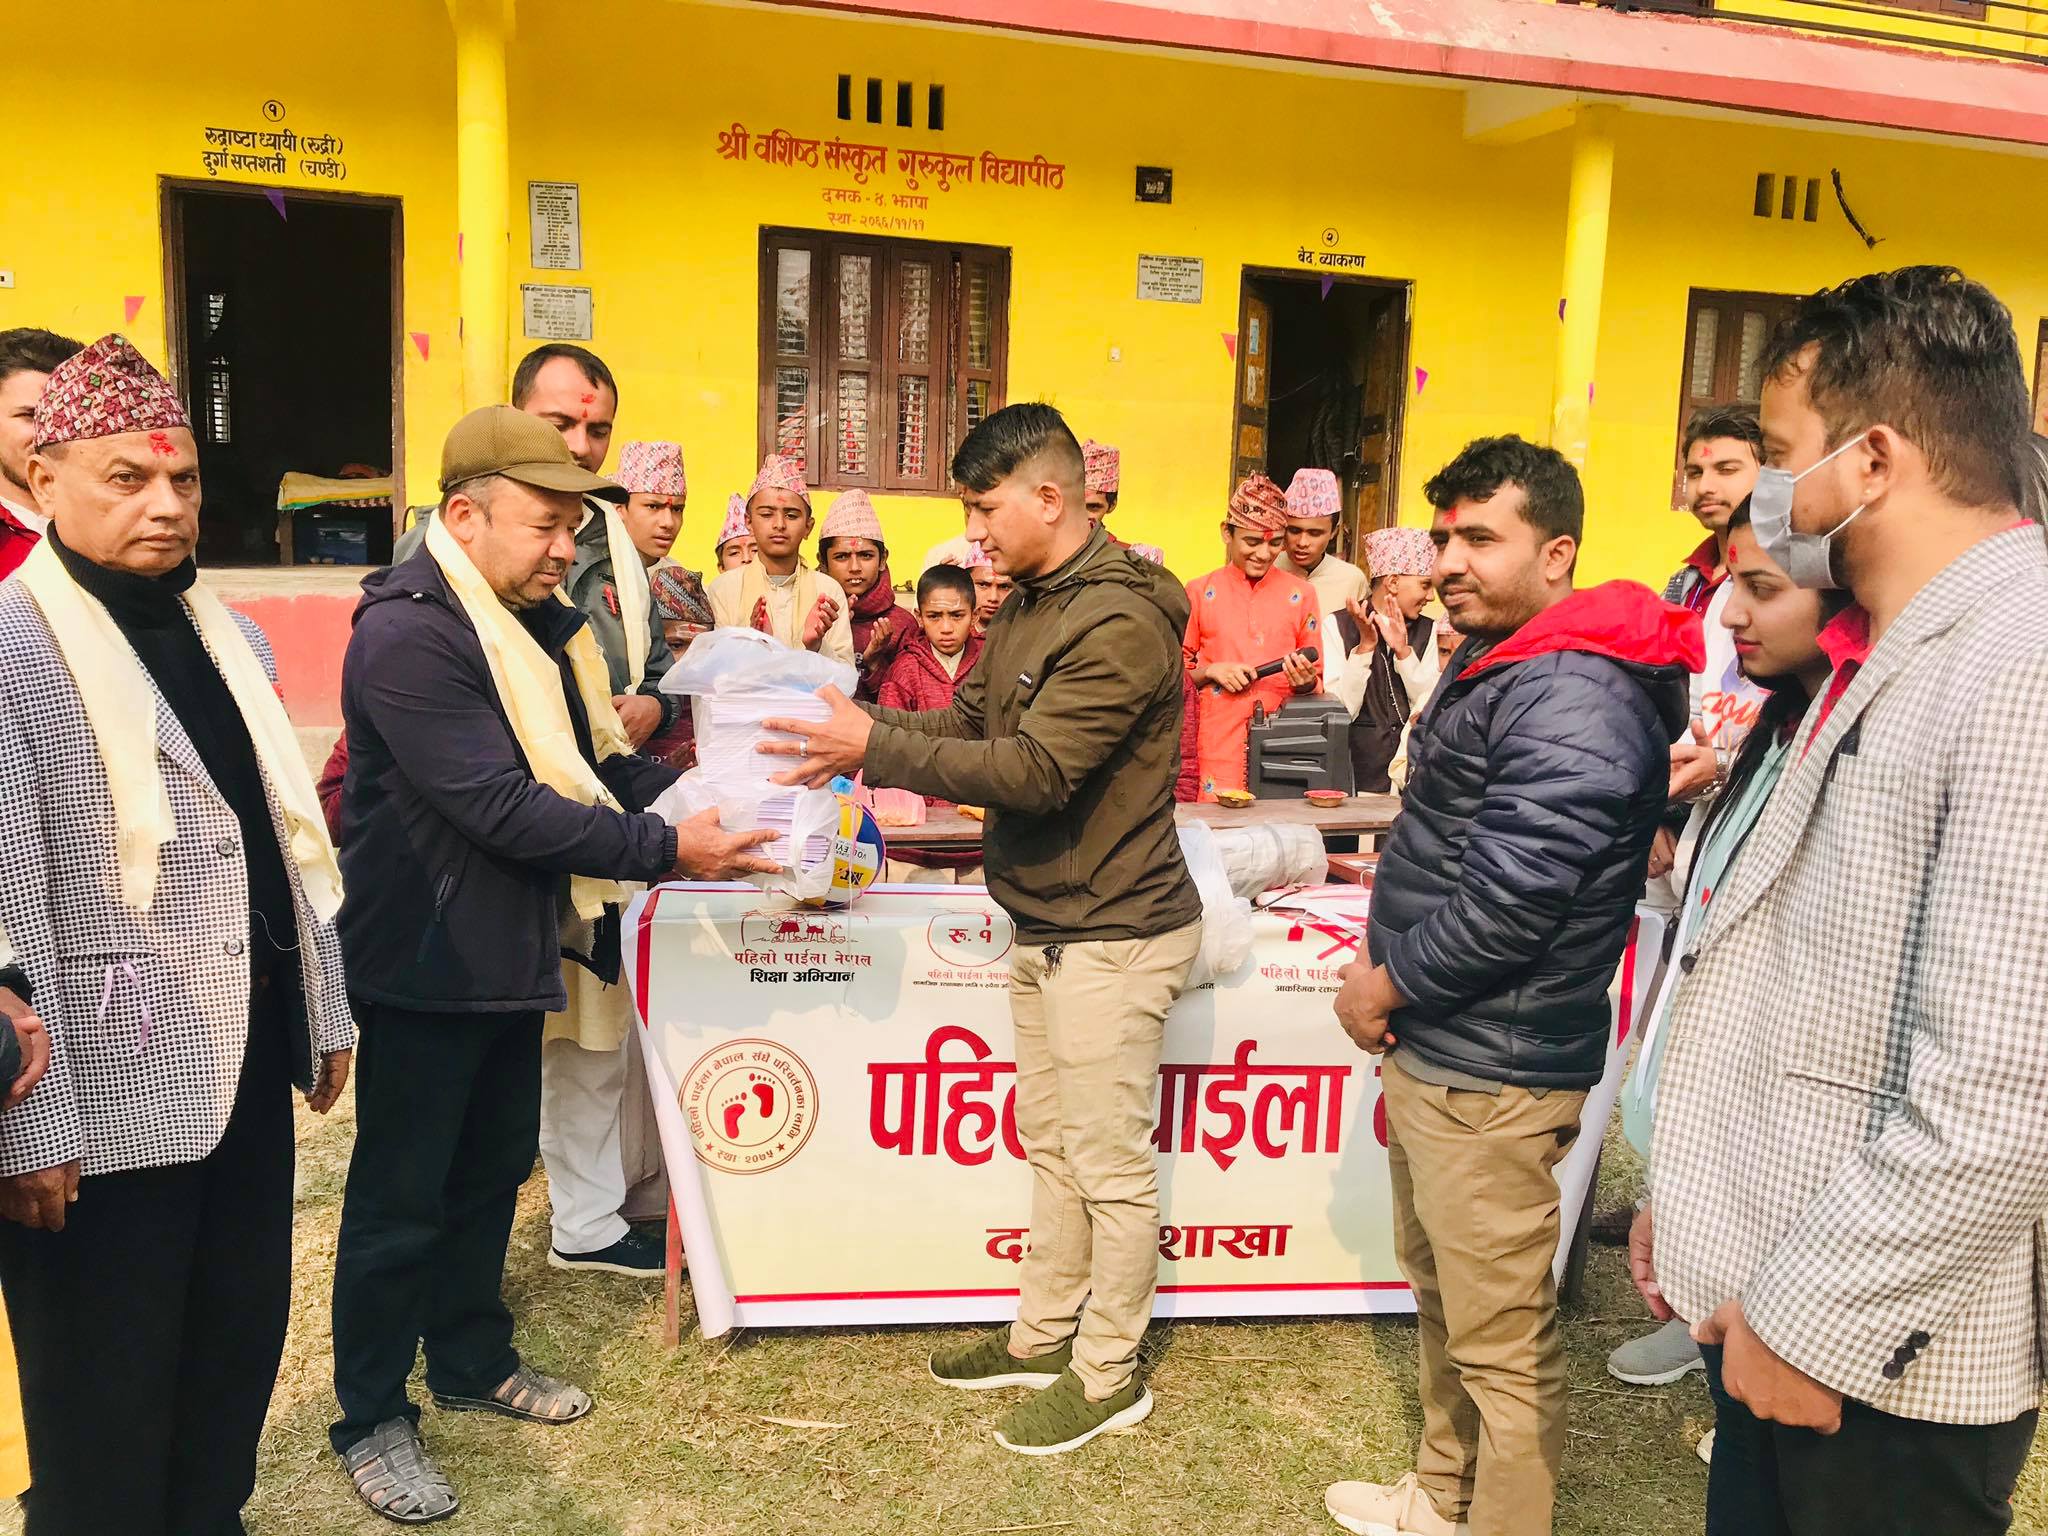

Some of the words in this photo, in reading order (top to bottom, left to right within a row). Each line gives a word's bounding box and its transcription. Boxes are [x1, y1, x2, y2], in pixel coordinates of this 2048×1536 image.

[202, 148, 229, 176] दुर्गा
[230, 152, 287, 175] सप्तशती
[300, 157, 347, 181] (चण्डी)
[717, 123, 750, 161] श्री
[754, 129, 820, 168] वशिष्ठ
[979, 150, 1066, 190] विद्यापीठ
[822, 187, 861, 204] दमक
[891, 193, 929, 210] झापा
[1319, 252, 1366, 269] व्याकरण
[734, 949, 777, 965] पहिलो
[785, 949, 827, 966] पाईला
[834, 951, 873, 967] नेपाल
[750, 968, 788, 983] शिक्षा
[792, 968, 856, 982] अभियान
[927, 969, 953, 980] पहिलो
[957, 969, 983, 980] पाईला
[1261, 963, 1300, 980] पहिलो
[1307, 965, 1340, 980] पाईल
[713, 1052, 745, 1071] नेपाल
[691, 1069, 713, 1102] पाईला
[687, 1105, 706, 1140] पहिलो
[1158, 1225, 1293, 1262] शाखा
